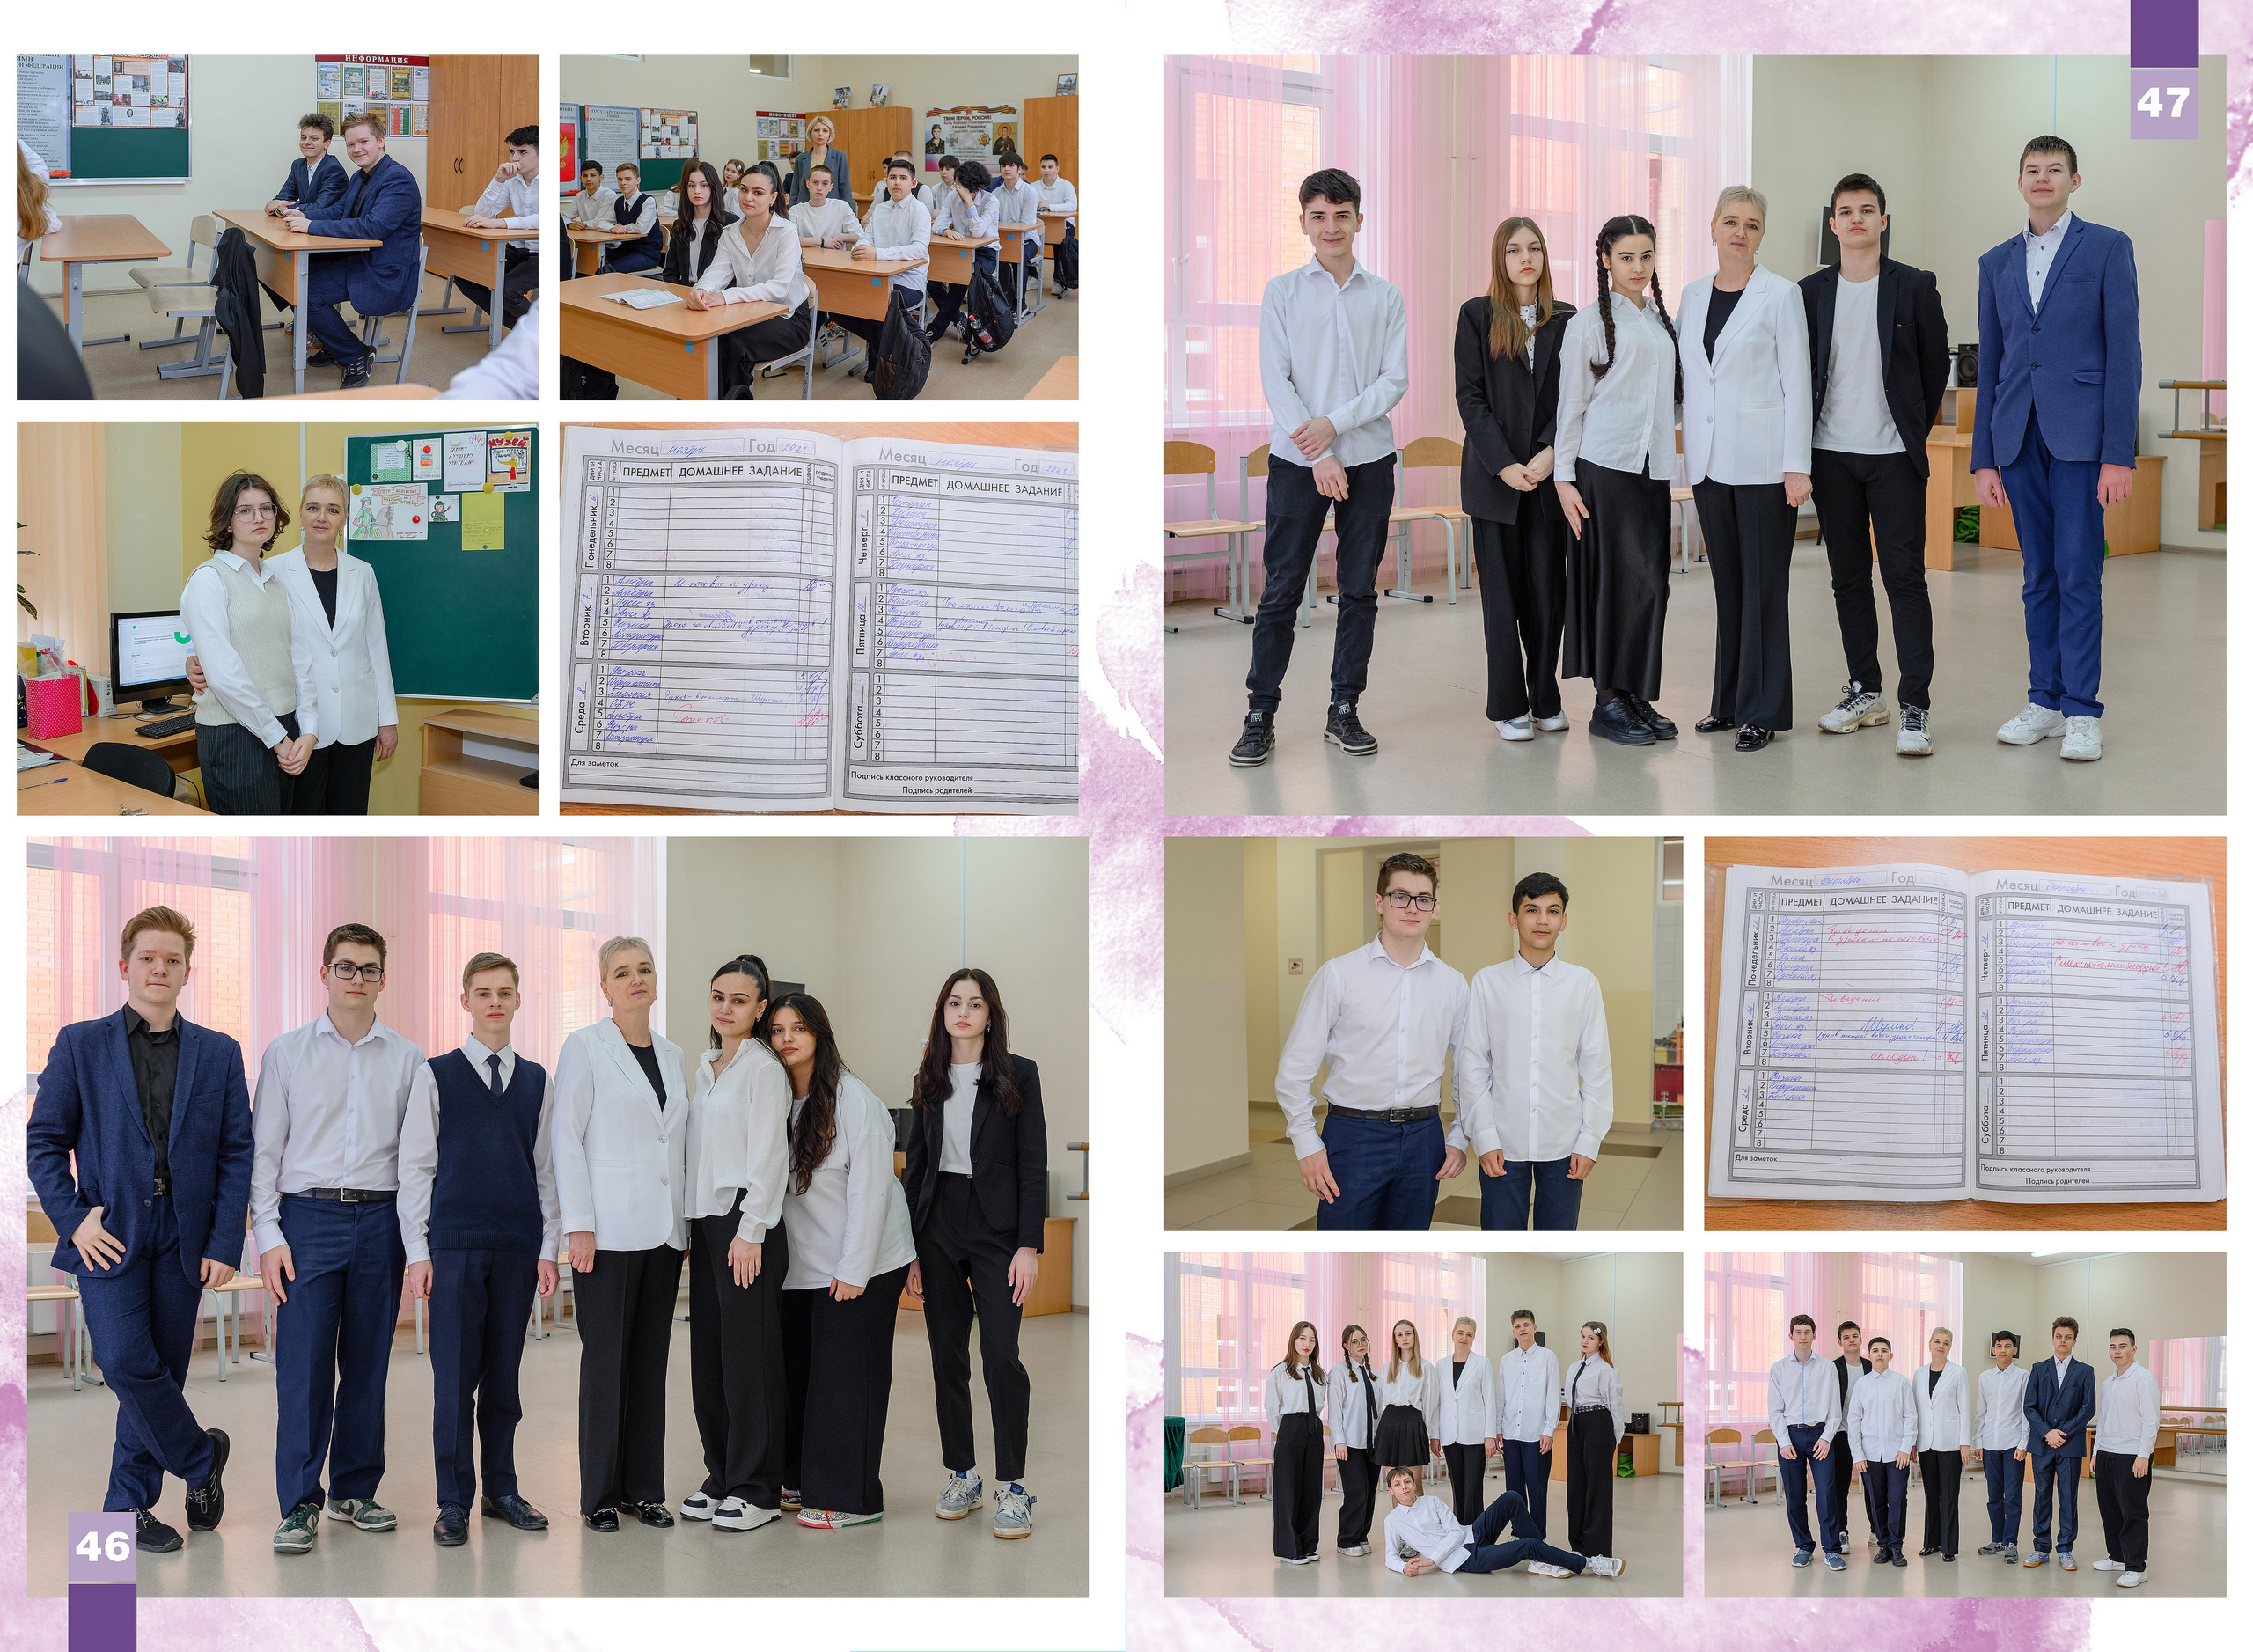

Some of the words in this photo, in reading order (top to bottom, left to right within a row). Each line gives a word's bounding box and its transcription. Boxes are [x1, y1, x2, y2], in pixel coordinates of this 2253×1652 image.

[345, 55, 409, 64] ИНФОРМАЦИЯ
[610, 440, 659, 457] Месяц
[749, 439, 775, 454] Год
[878, 448, 927, 466] Месяц
[1015, 459, 1038, 474] Год
[1046, 466, 1068, 475] 2023
[623, 467, 671, 478] ПРЕДМЕТ
[679, 466, 744, 478] ДОМАШНЕЕ
[749, 466, 803, 477] ЗАДАНИЕ
[892, 475, 938, 488] ПРЕДМЕТ
[946, 480, 1010, 493] ДОМАШНЕЕ
[1015, 485, 1063, 497] ЗАДАНИЕ
[585, 506, 598, 568] Понедельник
[858, 528, 870, 565] Четверг
[580, 606, 592, 646] Вторник
[856, 614, 867, 655] Пятница
[575, 701, 586, 733] Среда
[854, 705, 864, 748] Суббота
[851, 771, 884, 781] Подпись
[935, 787, 972, 796] родителей
[1771, 875, 1813, 888] Месяц
[1891, 871, 1915, 885] Год
[1996, 878, 2039, 892] Месяц
[2115, 885, 2136, 899] Год
[1781, 898, 1824, 907] ПРЕДМЕТ
[1830, 896, 1887, 907] ДОМАШНЕЕ
[1891, 895, 1938, 905] ЗАДАНИЕ
[2008, 901, 2051, 912] ПРЕДМЕТ
[2057, 904, 2112, 916] ДОМАШНЕЕ
[2116, 907, 2158, 919] ЗАДАНИЕ
[1748, 931, 1759, 986] Понедельник
[1981, 949, 1991, 981] Четверг
[1743, 1019, 1754, 1054] Вторник
[1738, 1104, 1749, 1132] Среда
[1981, 1105, 1991, 1144] Суббота
[2056, 1177, 2090, 1186] родителей
